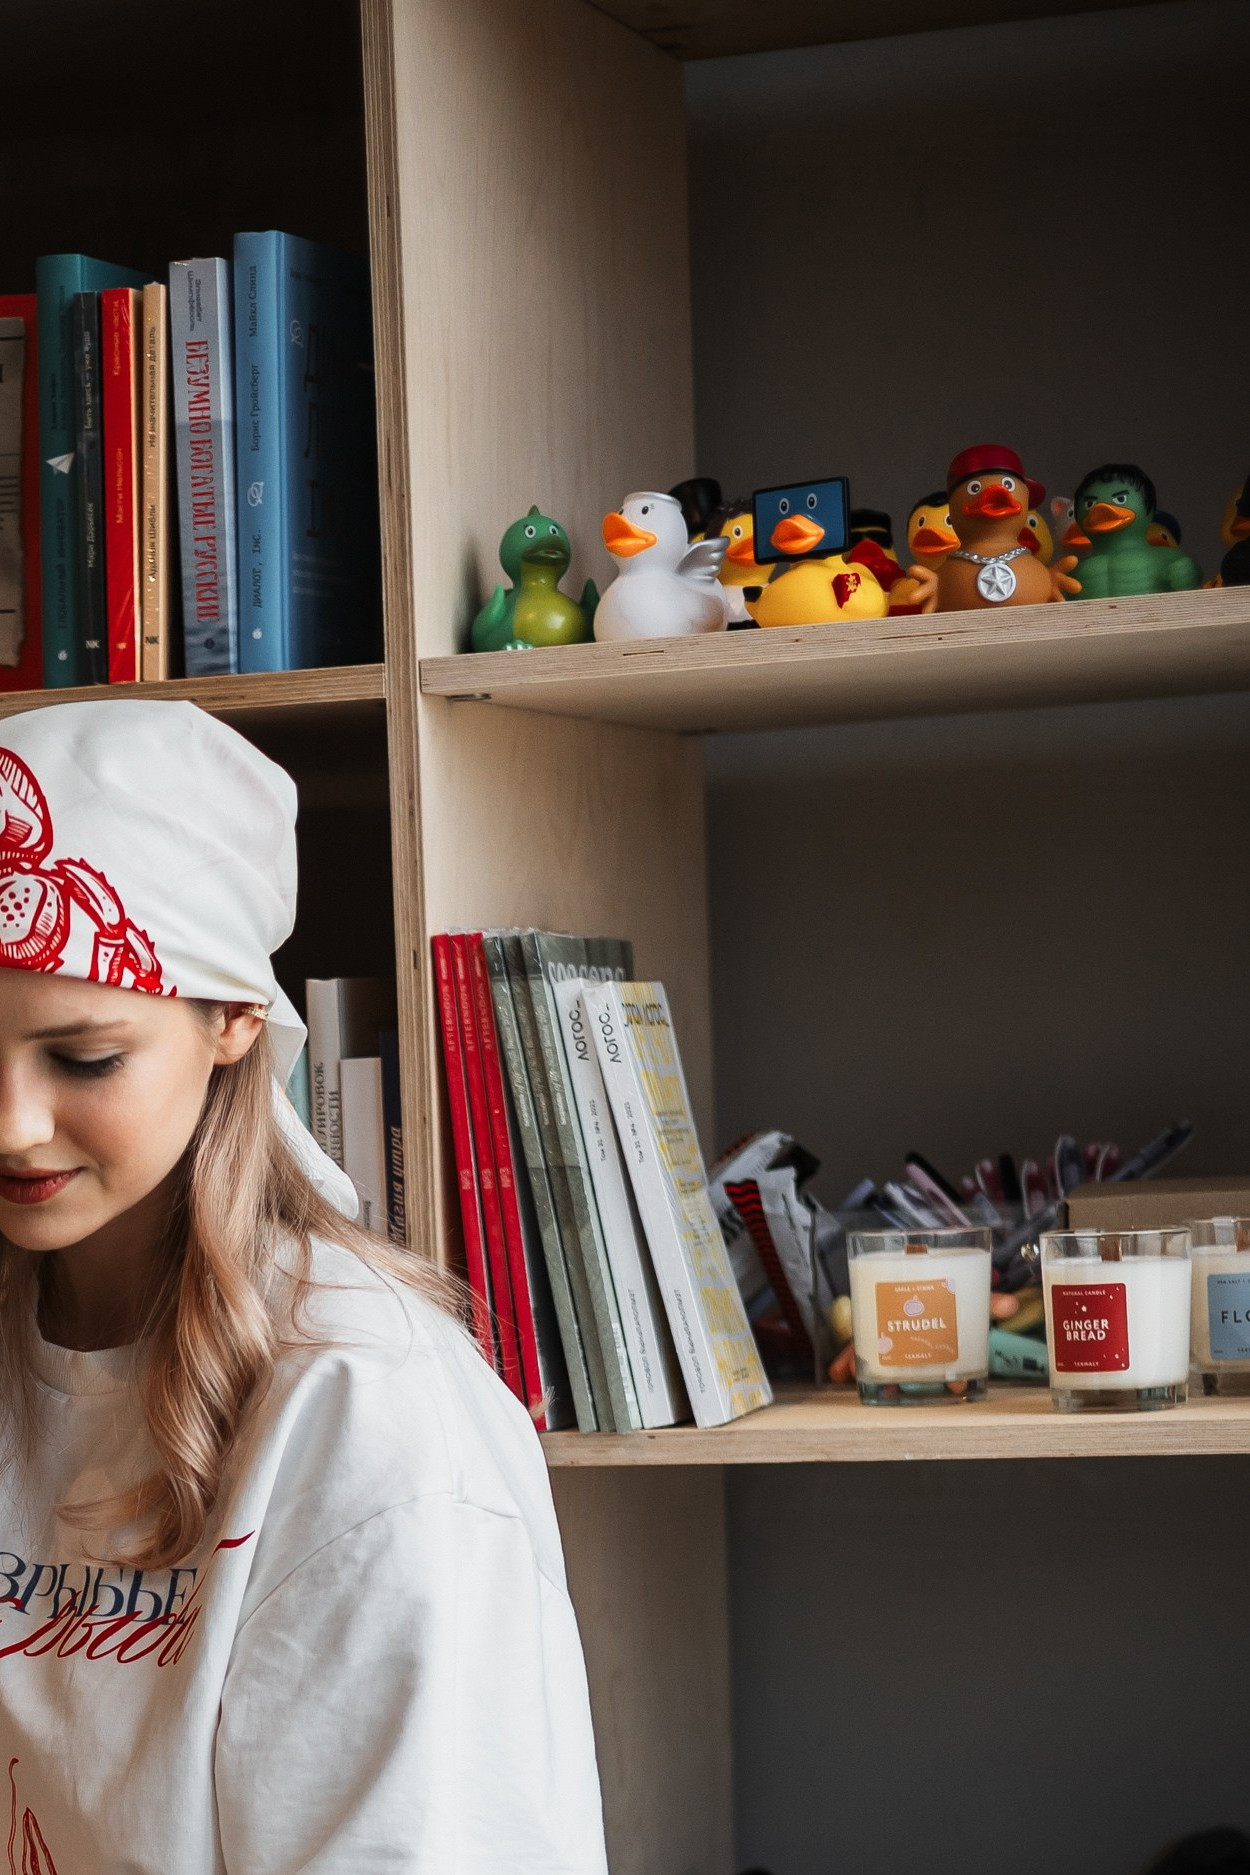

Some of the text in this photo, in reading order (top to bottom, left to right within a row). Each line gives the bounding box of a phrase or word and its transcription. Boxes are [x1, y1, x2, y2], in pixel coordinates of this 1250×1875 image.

[246, 303, 258, 337] Майкл
[248, 421, 260, 452] Борис
[183, 339, 220, 623] БЕЗУМНО БОГАТЫЕ РУССКИЕ
[389, 1125, 404, 1177] утра
[887, 1317, 947, 1333] STRUDEL
[1062, 1318, 1110, 1331] GINGER
[1066, 1330, 1107, 1342] BREAD
